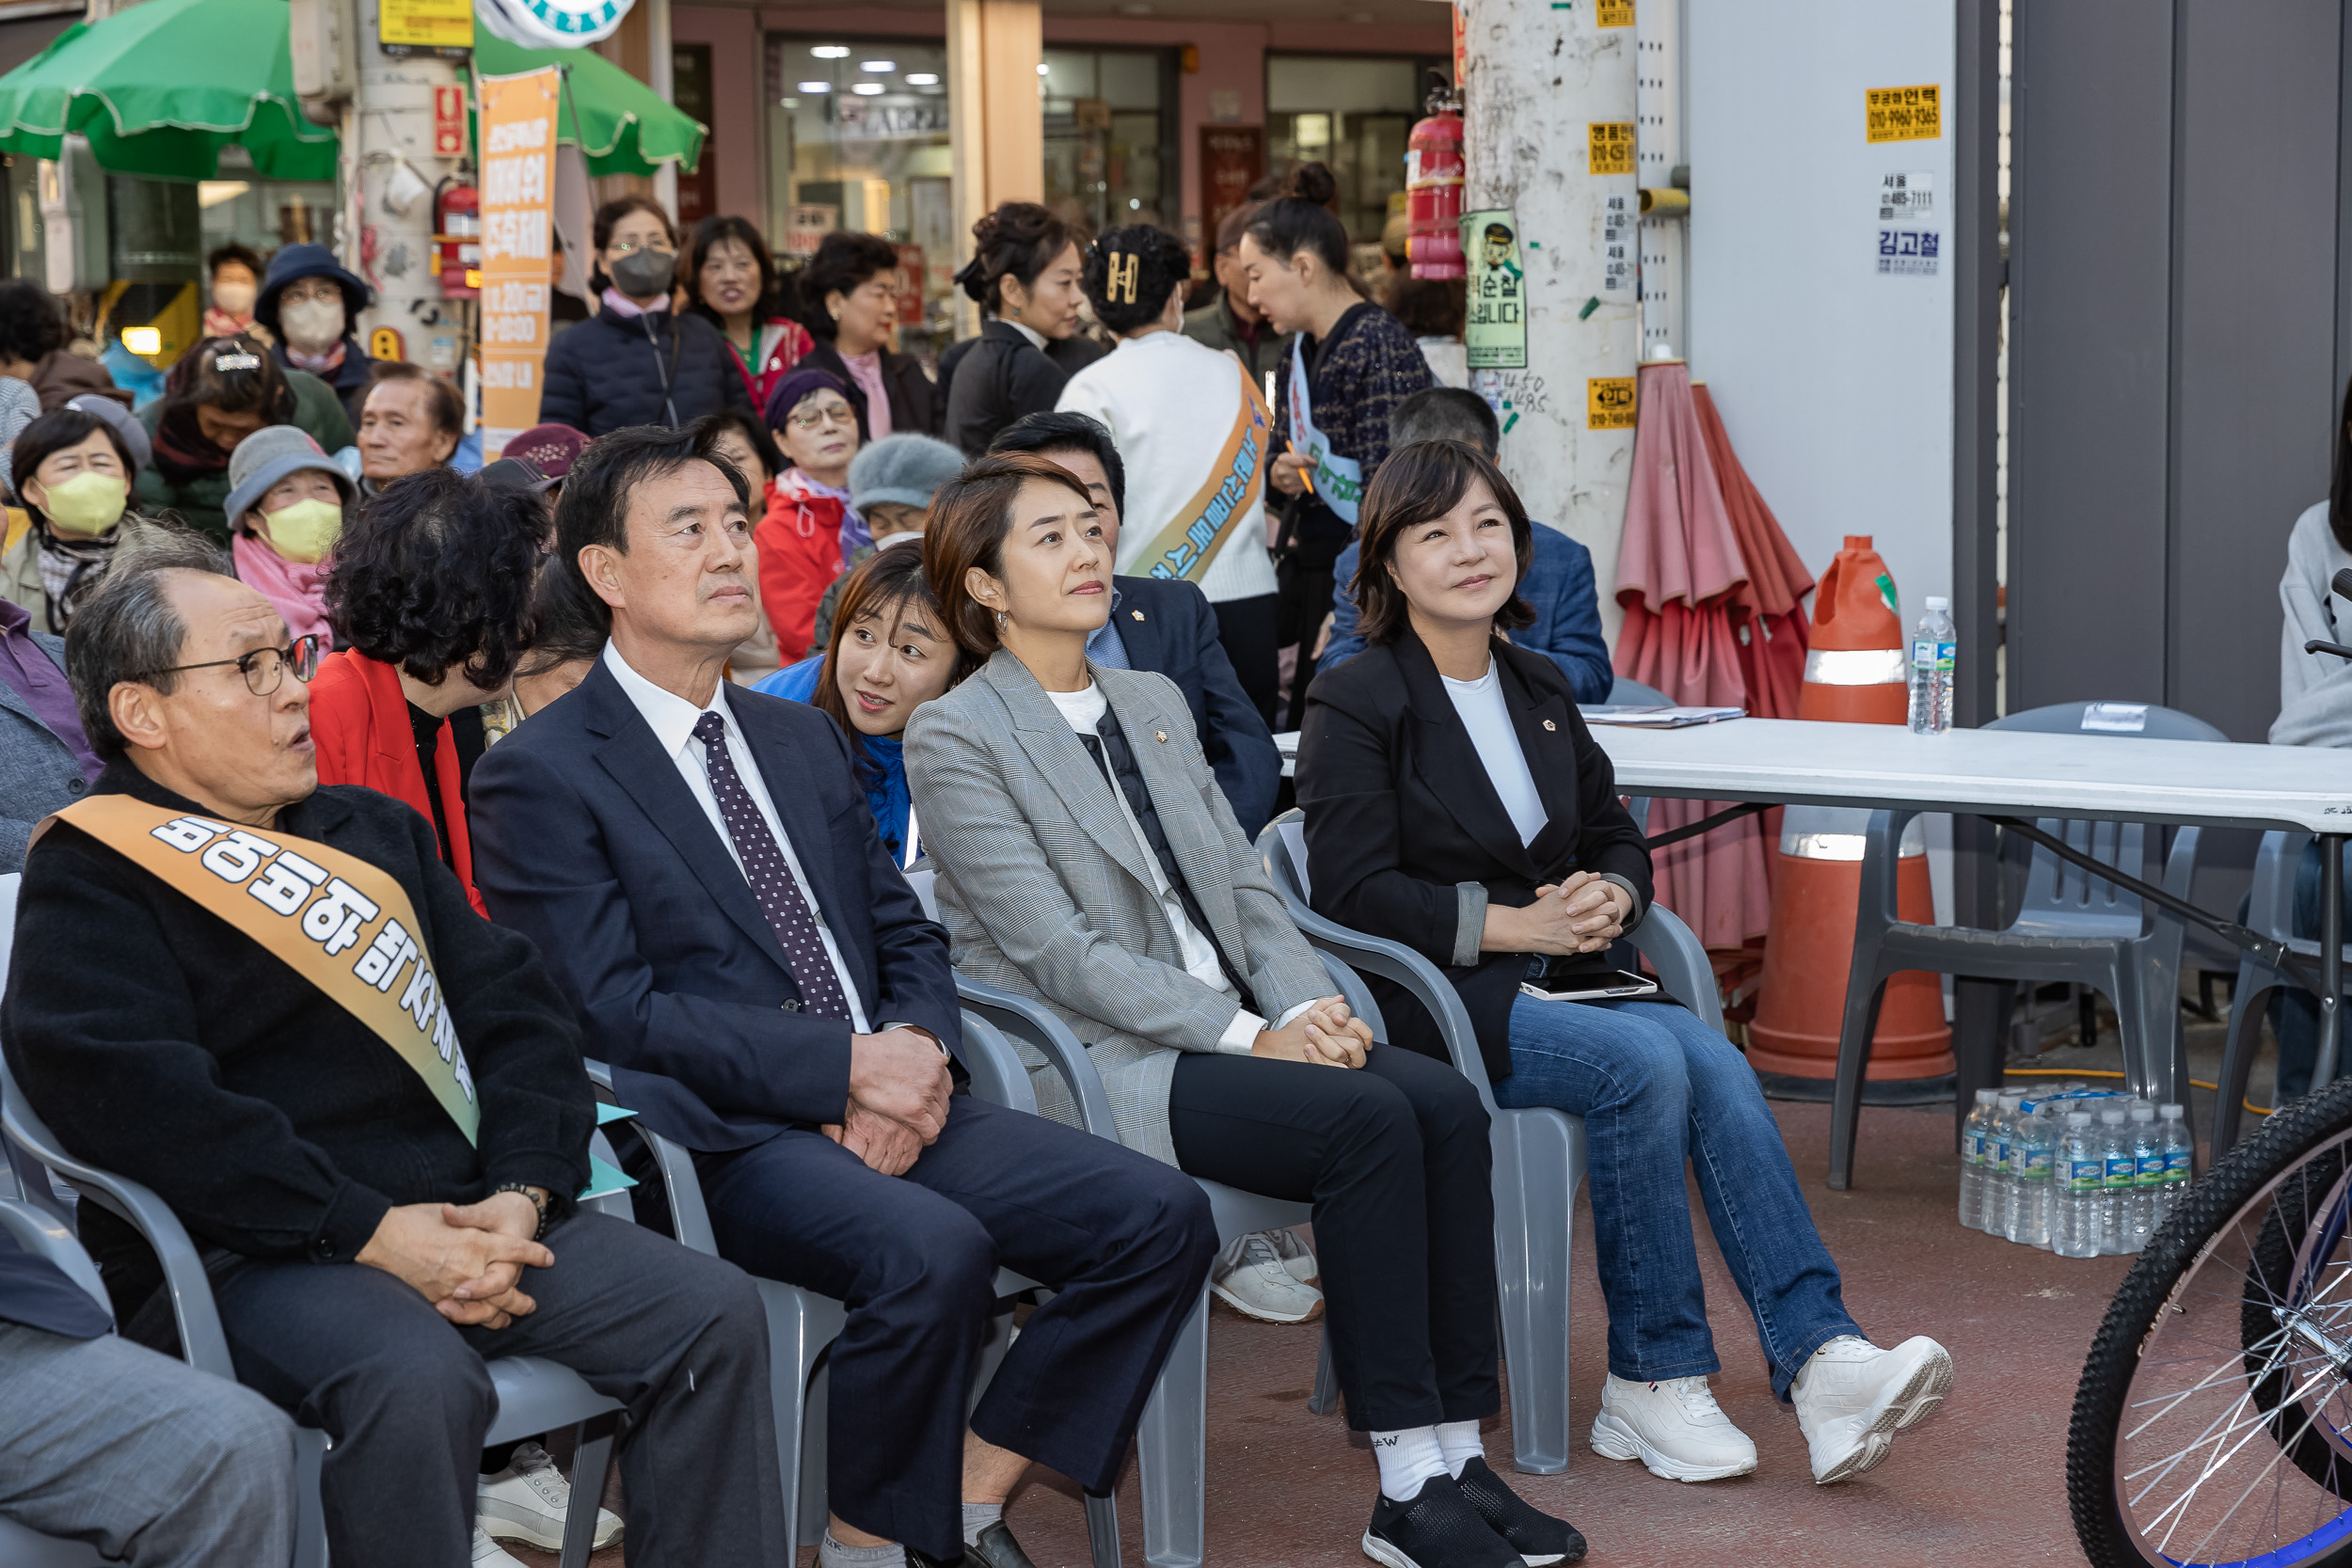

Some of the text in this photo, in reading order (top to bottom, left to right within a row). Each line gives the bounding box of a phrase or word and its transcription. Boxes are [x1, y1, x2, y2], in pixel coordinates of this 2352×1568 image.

[1883, 174, 1907, 189] 서울
[1608, 198, 1625, 211] 서울
[1880, 231, 1939, 258] 김고철
[1608, 246, 1625, 259] 서울
